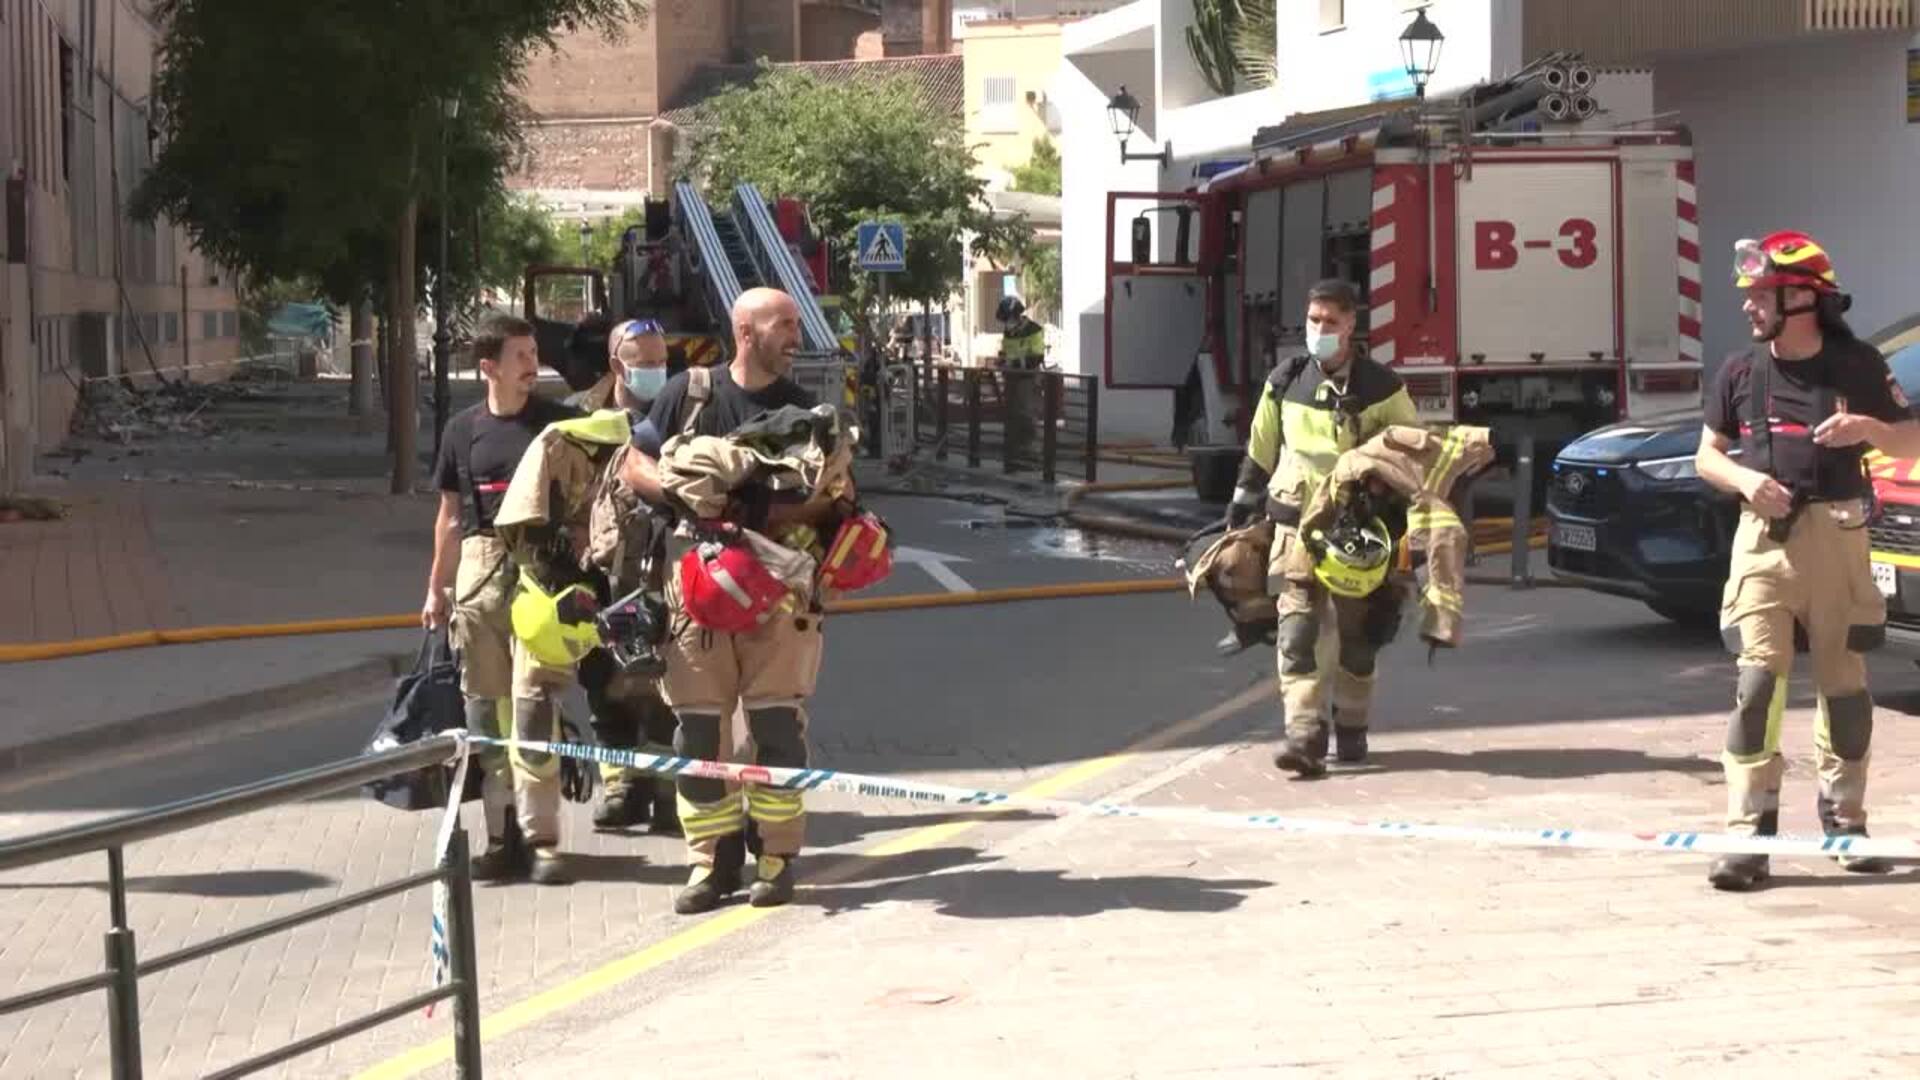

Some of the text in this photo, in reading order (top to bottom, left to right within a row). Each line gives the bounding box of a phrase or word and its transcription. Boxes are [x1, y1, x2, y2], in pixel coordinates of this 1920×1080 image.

[1475, 218, 1598, 269] B-3
[859, 783, 945, 803] POLICIA LOCAL
